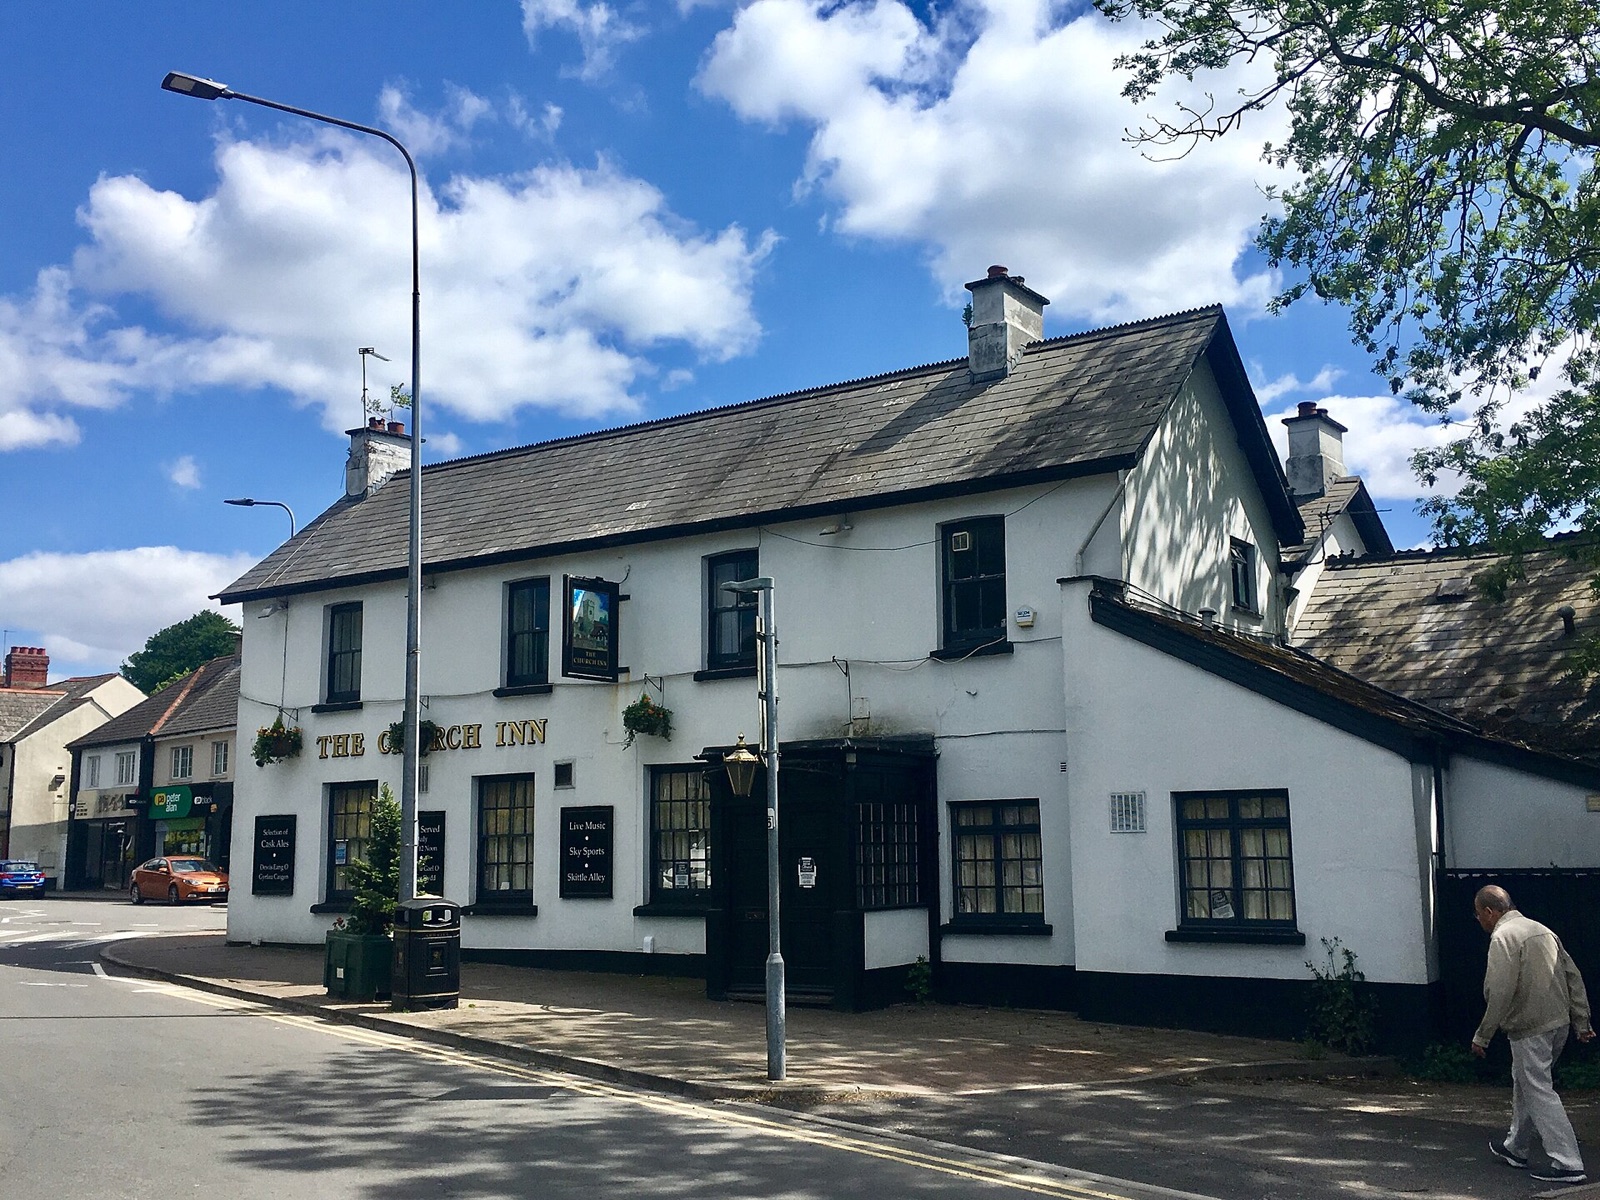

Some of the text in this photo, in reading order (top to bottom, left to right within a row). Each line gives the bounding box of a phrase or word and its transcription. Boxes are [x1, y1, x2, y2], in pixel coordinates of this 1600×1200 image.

[316, 718, 548, 760] THE CRCH INN
[166, 793, 181, 805] peter
[165, 803, 178, 812] alan
[420, 824, 441, 834] Served
[569, 821, 606, 830] Live Music
[263, 828, 289, 836] Selection of
[261, 839, 289, 848] Cask Ales
[569, 846, 605, 858] Sky Sports
[567, 872, 606, 884] Skittle Alley
